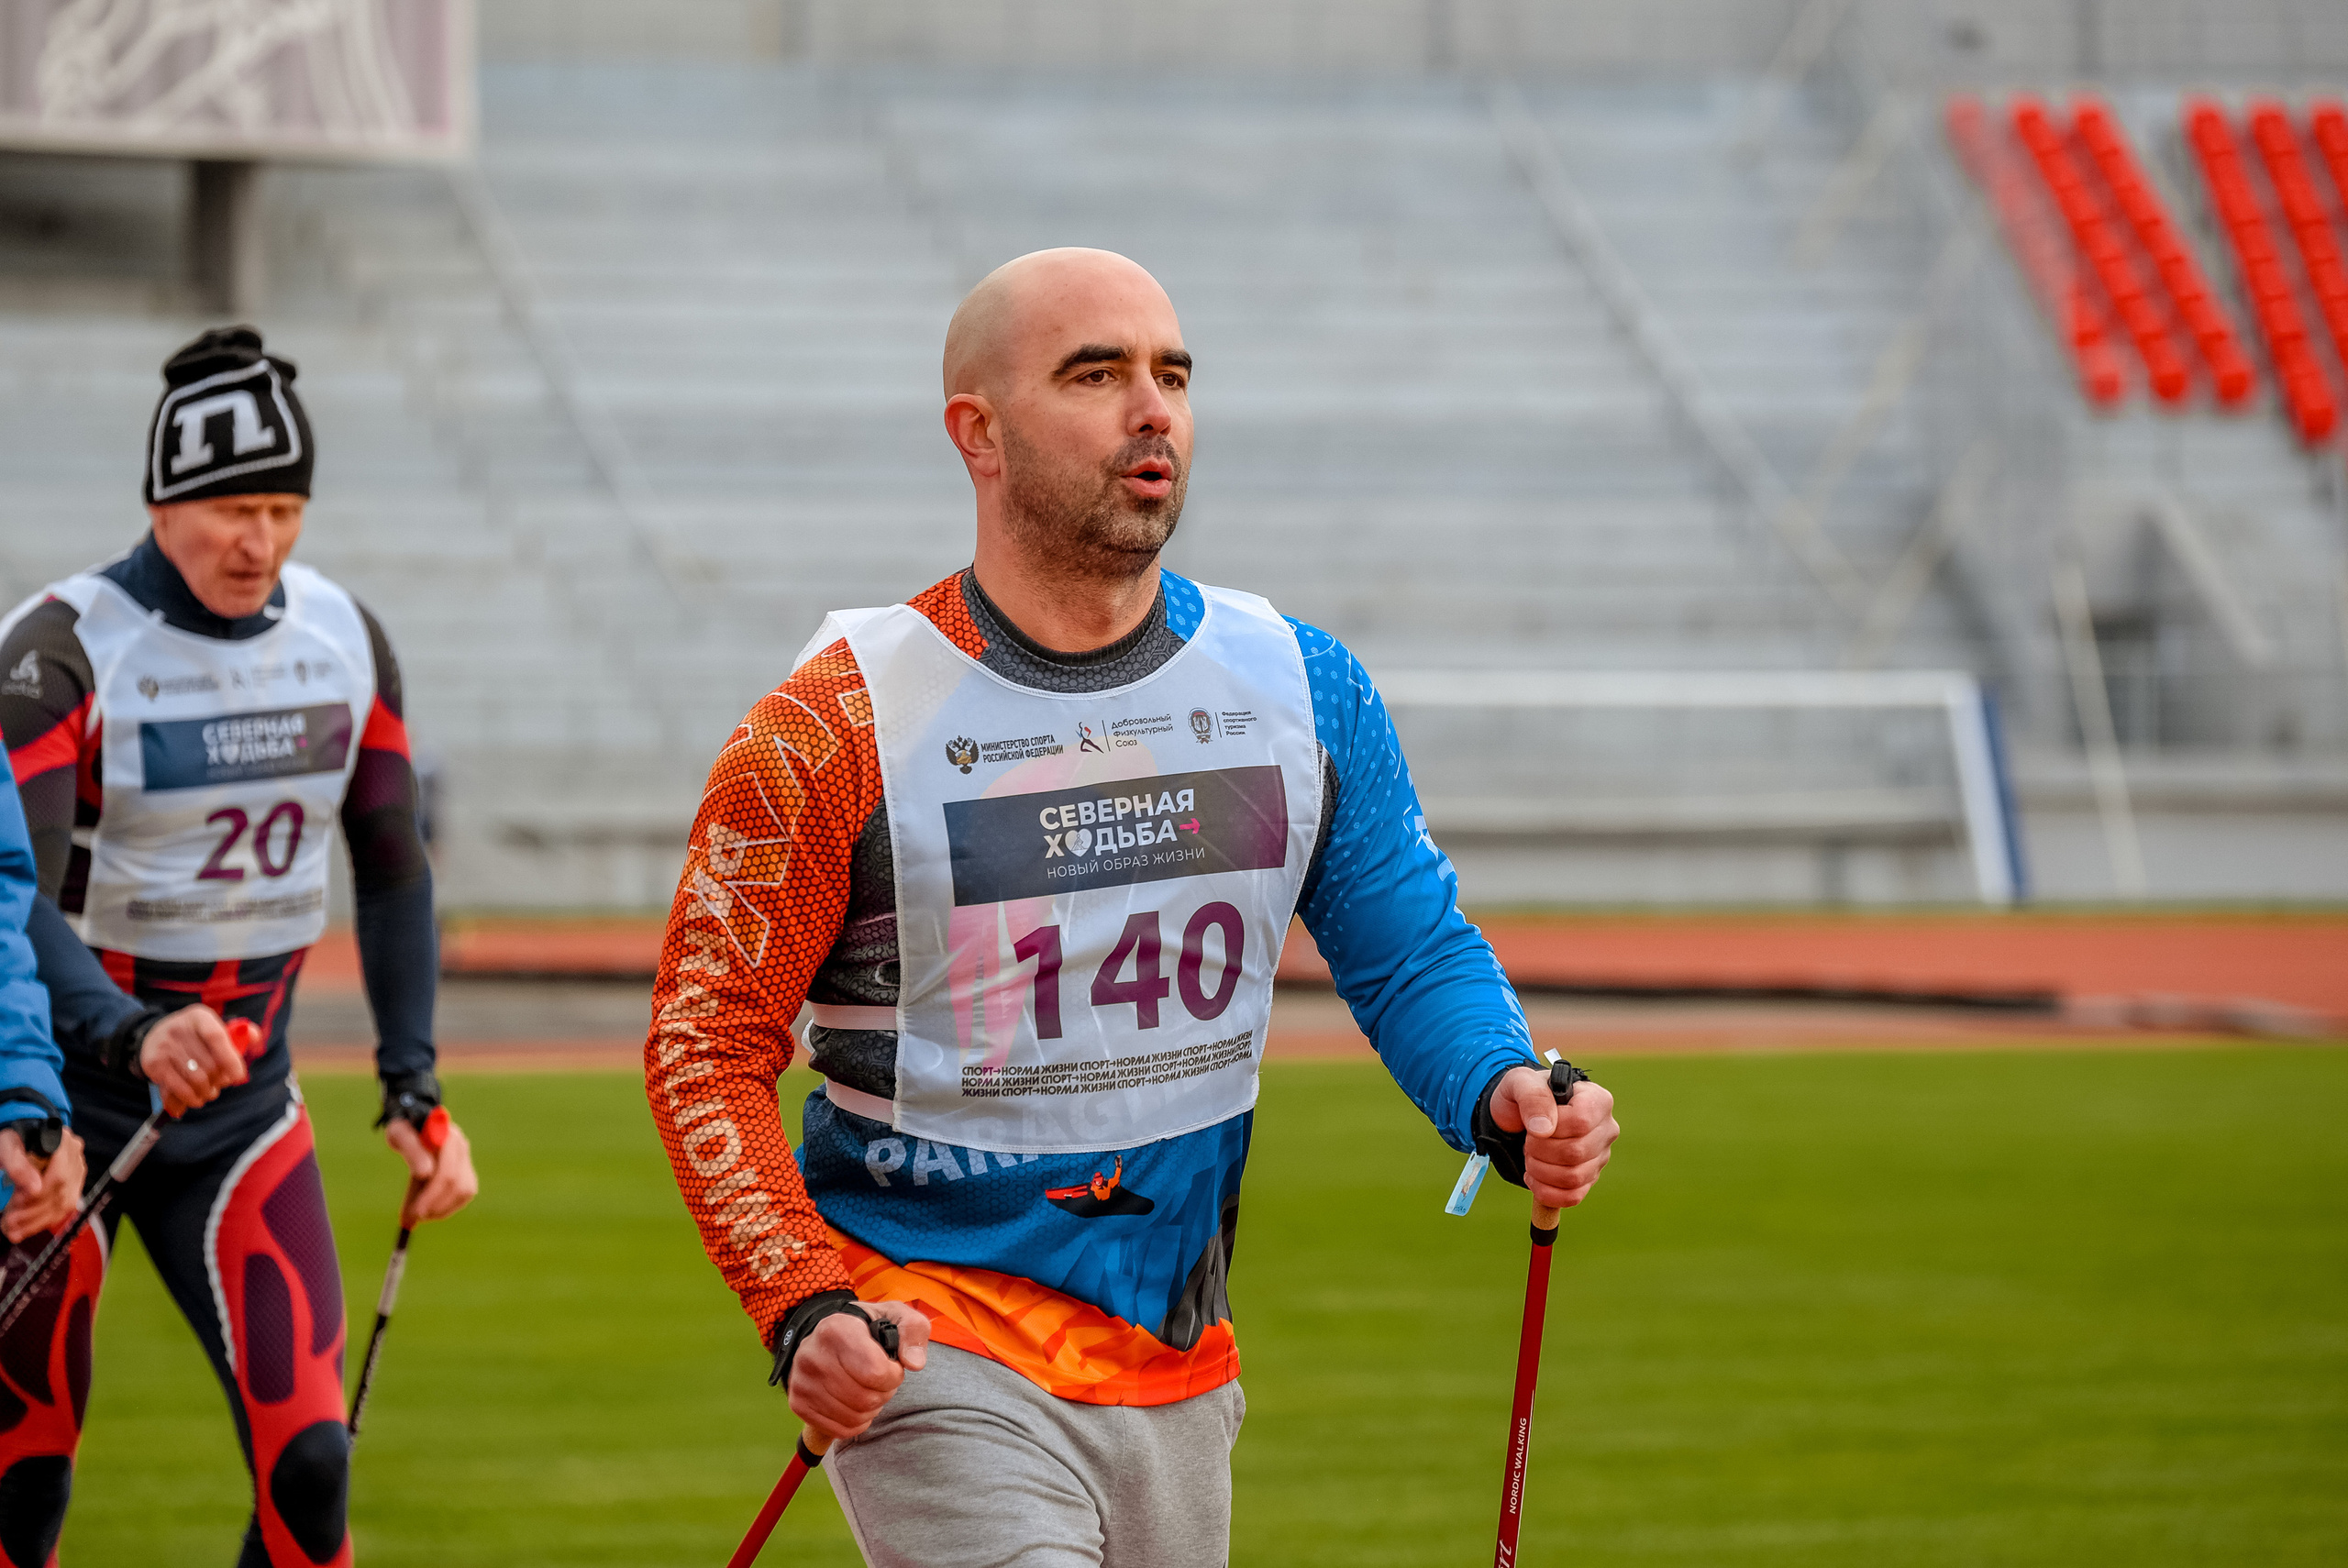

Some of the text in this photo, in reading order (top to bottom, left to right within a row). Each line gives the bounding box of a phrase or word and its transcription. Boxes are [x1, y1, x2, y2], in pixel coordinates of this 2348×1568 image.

[1111, 713, 1171, 729] Добровольный
[1113, 724, 1173, 737] Физкультурный
[980, 734, 1055, 752] МИНИСТЕРСТВО СПОРТА
[983, 745, 1063, 763] РОССИЙСКОЙ ФЕДЕРАЦИИ
[1115, 739, 1137, 747] Союз
[1039, 789, 1194, 830] СЕВЕРНАЯ
[198, 801, 304, 880] 20
[1047, 847, 1205, 878] НОВЫЙ ОБРАЗ ЖИЗНИ
[1013, 901, 1245, 1040] 140
[961, 1077, 1000, 1087] НОРМА
[1002, 1076, 1039, 1087] ЖИЗНИ
[1041, 1074, 1072, 1085] СПОРТ
[1080, 1069, 1116, 1082] НОРМА
[1117, 1066, 1150, 1078] ЖИЗНИ
[1152, 1061, 1178, 1073] СПОРТ
[1182, 1055, 1211, 1068] НОРМА
[962, 1066, 993, 1076] СПОРТ
[1002, 1066, 1039, 1076] НОРМА
[1040, 1062, 1078, 1074] ЖИЗНИ
[1080, 1060, 1110, 1071] СПОРТ
[1116, 1056, 1150, 1068] НОРМА
[1150, 1050, 1182, 1063] ЖИЗНИ
[1182, 1044, 1208, 1057] СПОРТ
[961, 1088, 1000, 1098] ЖИЗНИ
[1002, 1087, 1033, 1097] СПОРТ
[1041, 1085, 1079, 1096] НОРМА
[1080, 1081, 1116, 1093] ЖИЗНИ
[1117, 1077, 1146, 1089] СПОРТ
[1152, 1072, 1180, 1085] НОРМА
[1181, 1064, 1209, 1078] ЖИЗНИ
[1509, 1418, 1527, 1515] NORDIC WALKING
